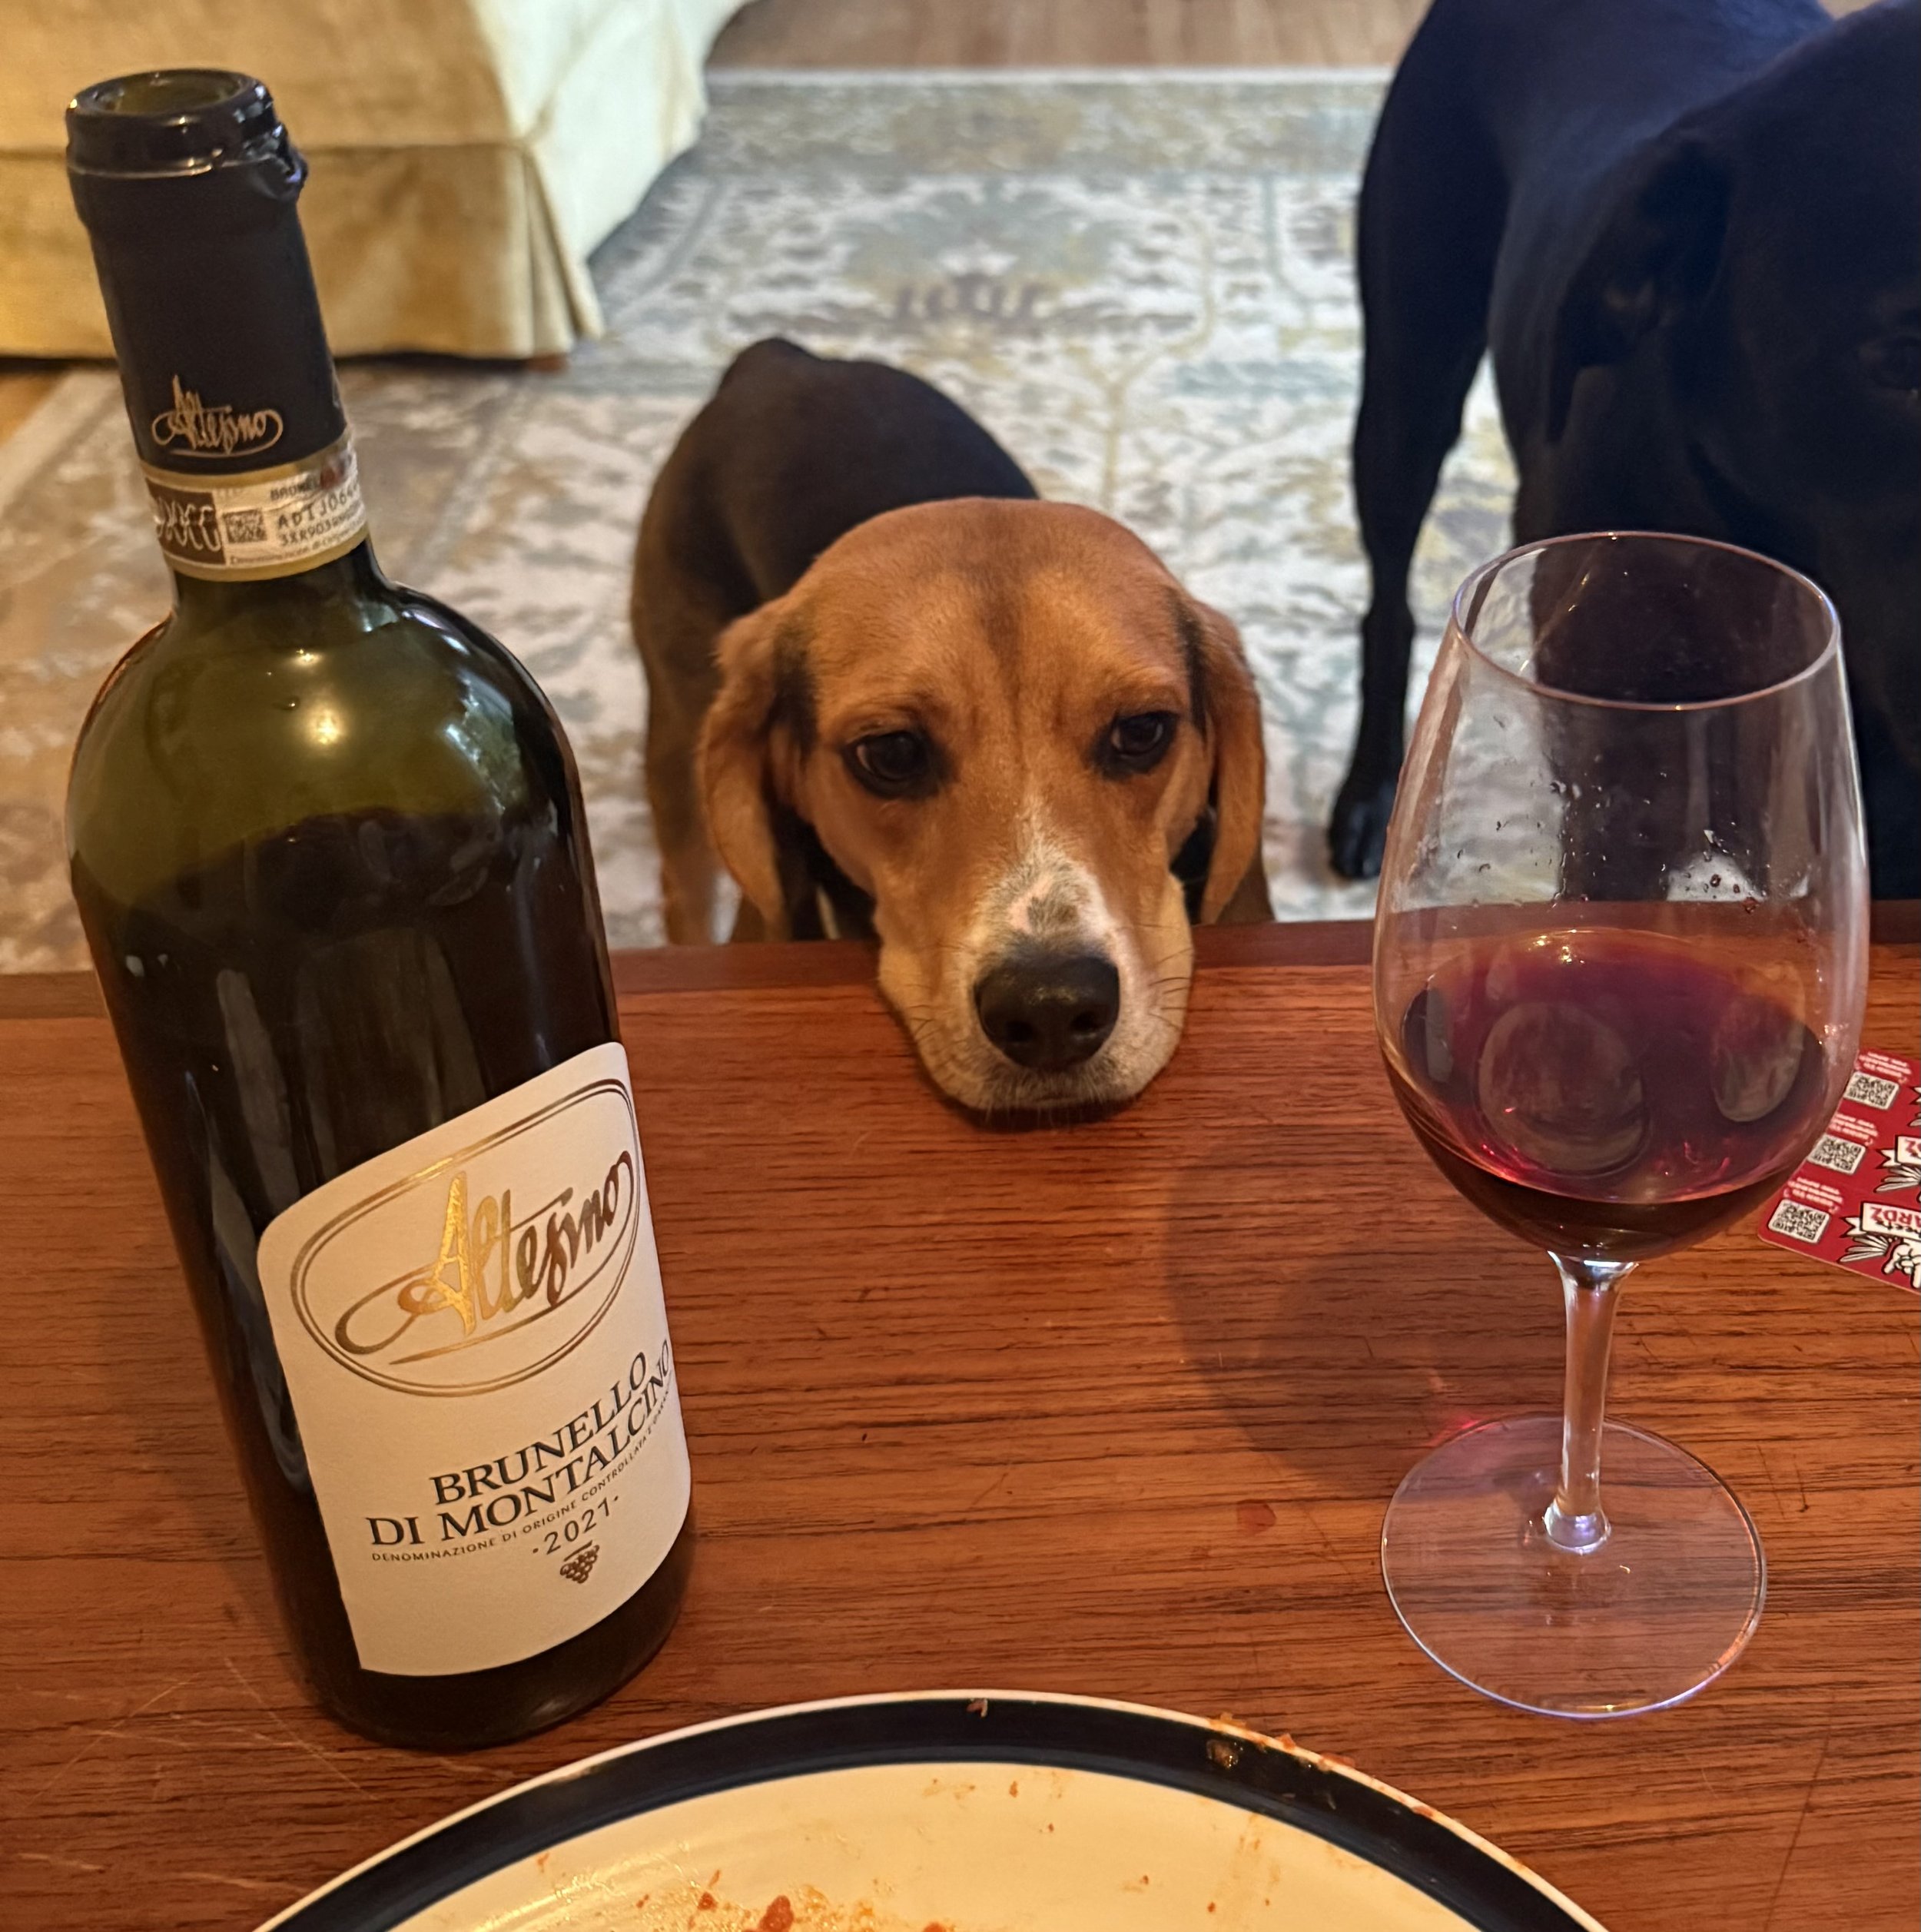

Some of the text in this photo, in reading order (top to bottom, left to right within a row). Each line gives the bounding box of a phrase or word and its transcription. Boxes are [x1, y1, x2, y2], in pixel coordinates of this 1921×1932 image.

[366, 1339, 669, 1545] DI MONTALCINO
[372, 1536, 498, 1562] DENOMINAZIONE
[502, 1530, 517, 1542] DI
[523, 1499, 577, 1534] ORIGINE
[582, 1436, 646, 1502] CONTROLLATA
[429, 1352, 646, 1505] BRUNELLO
